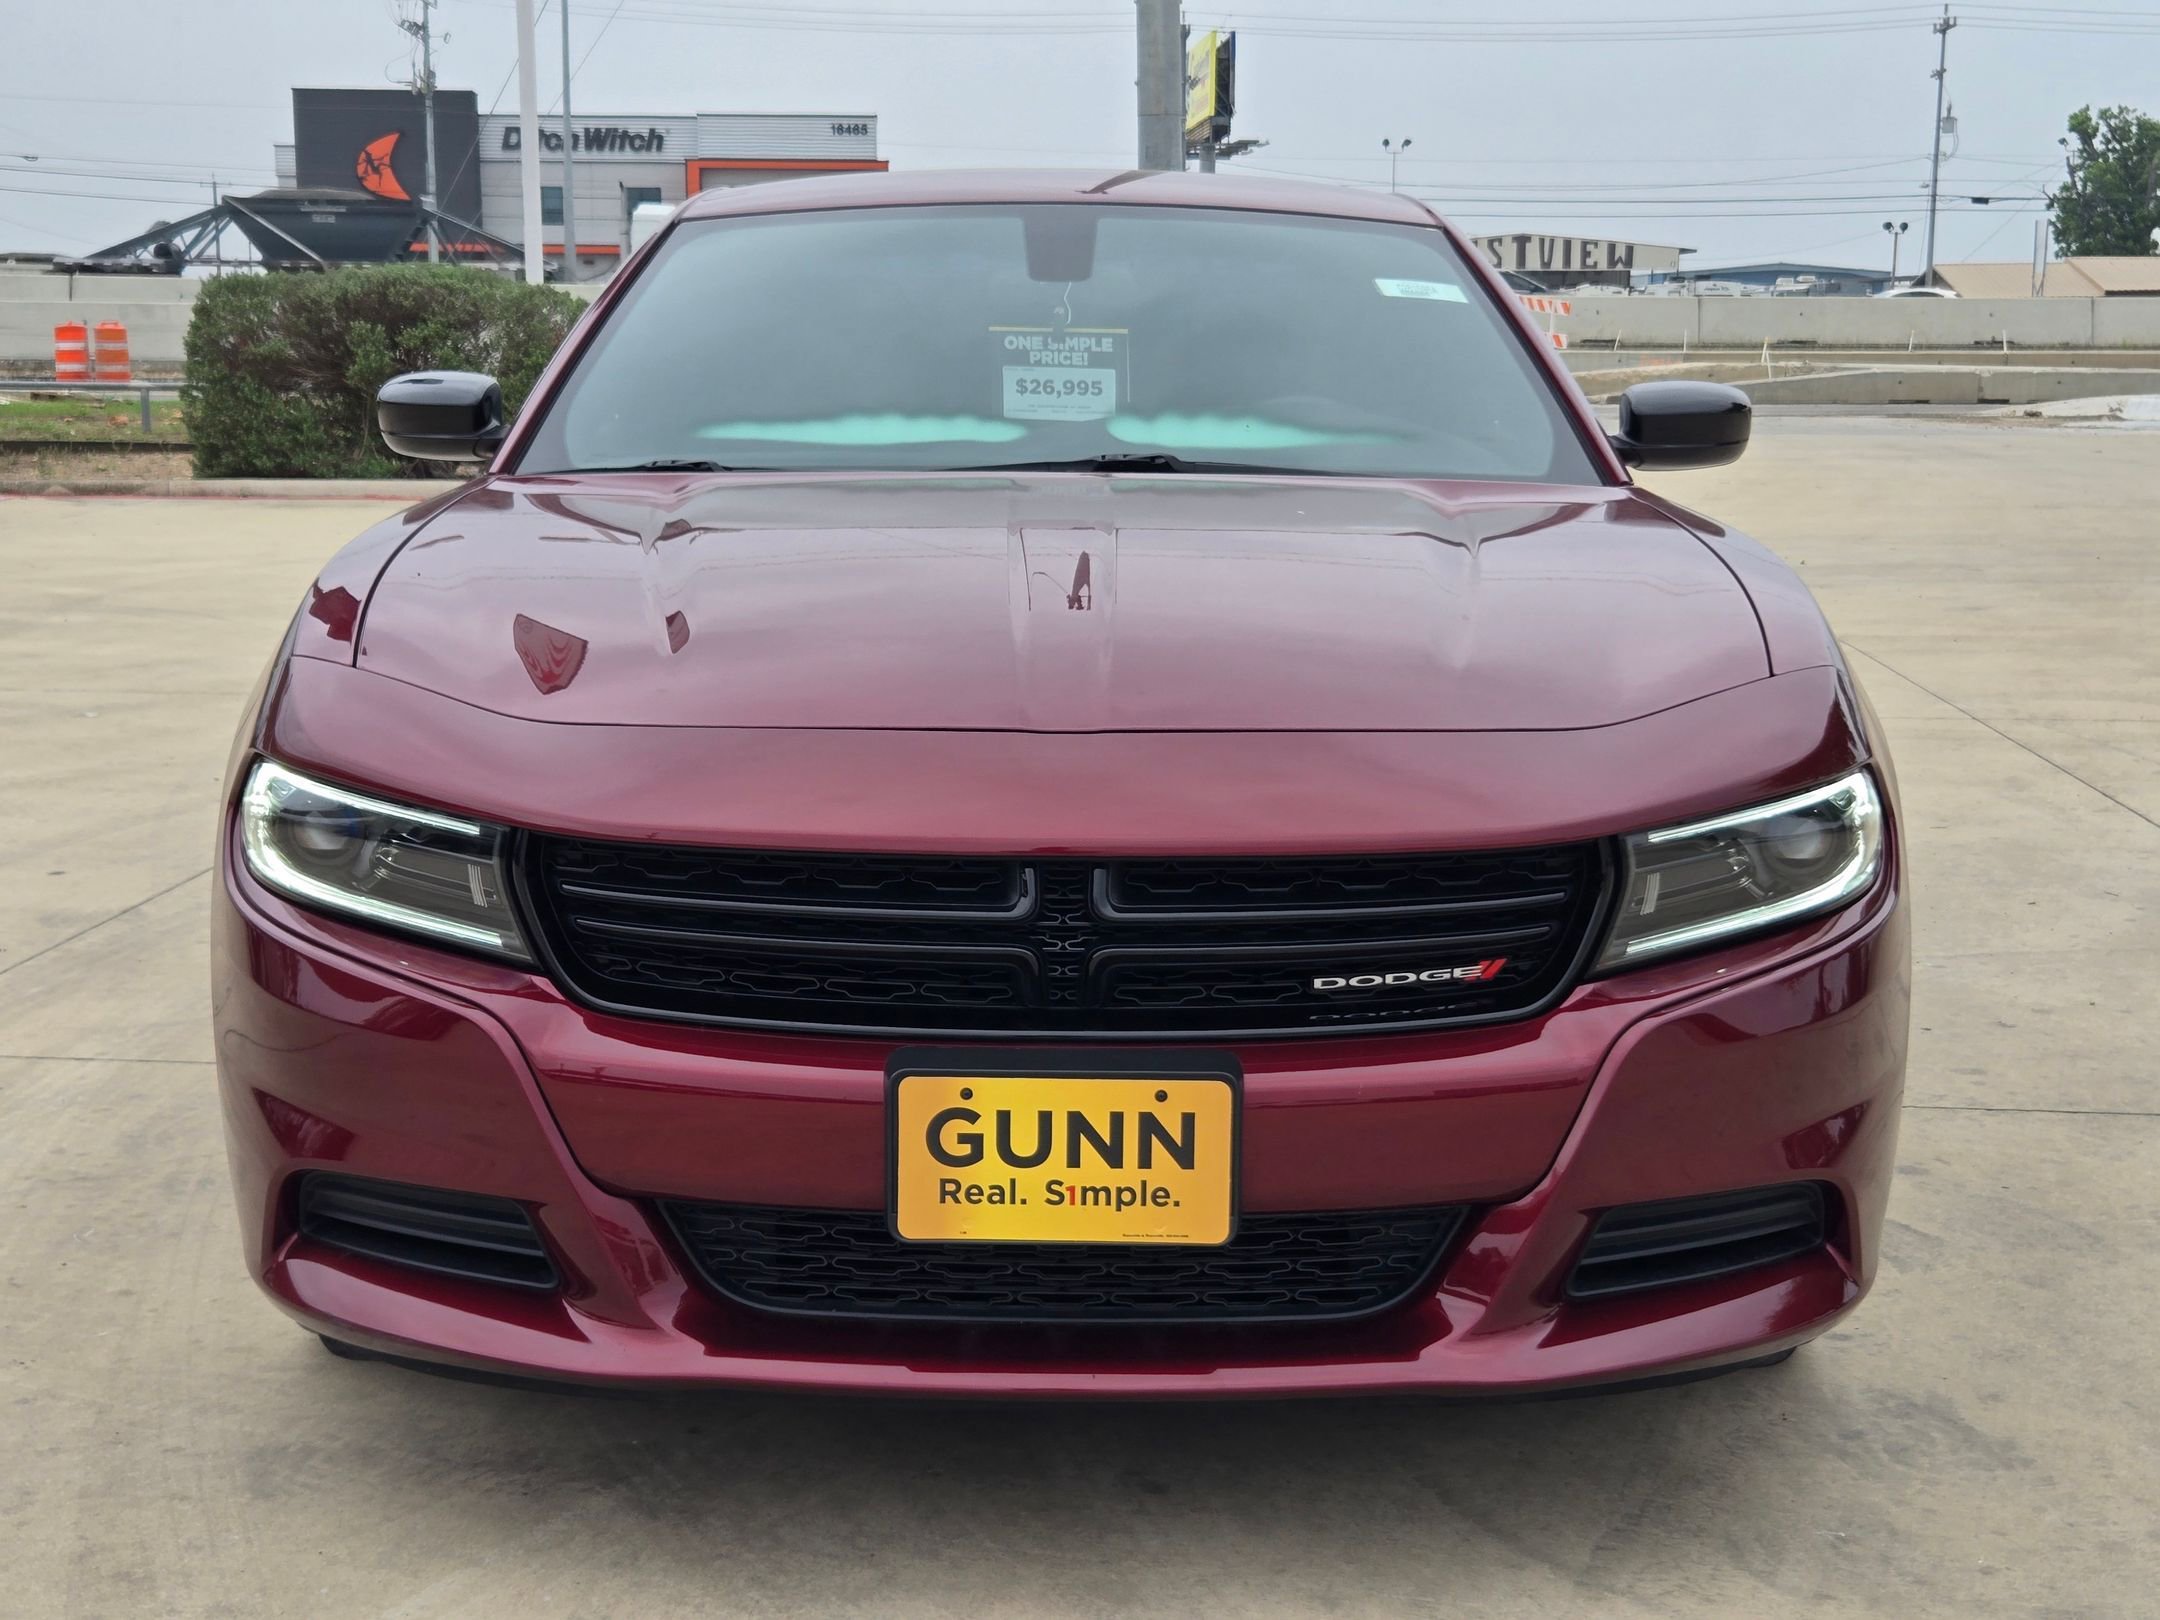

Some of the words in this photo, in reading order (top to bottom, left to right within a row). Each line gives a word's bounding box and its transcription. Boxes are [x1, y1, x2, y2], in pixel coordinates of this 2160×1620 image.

[584, 127, 664, 152] Witch
[1472, 235, 1634, 270] STVIEW
[1004, 335, 1043, 351] ONE
[1029, 351, 1088, 365] PRICE!
[1015, 378, 1103, 399] $26,995
[1313, 964, 1483, 990] DODGE
[925, 1106, 1195, 1170] GUNN
[939, 1177, 1027, 1207] Real.
